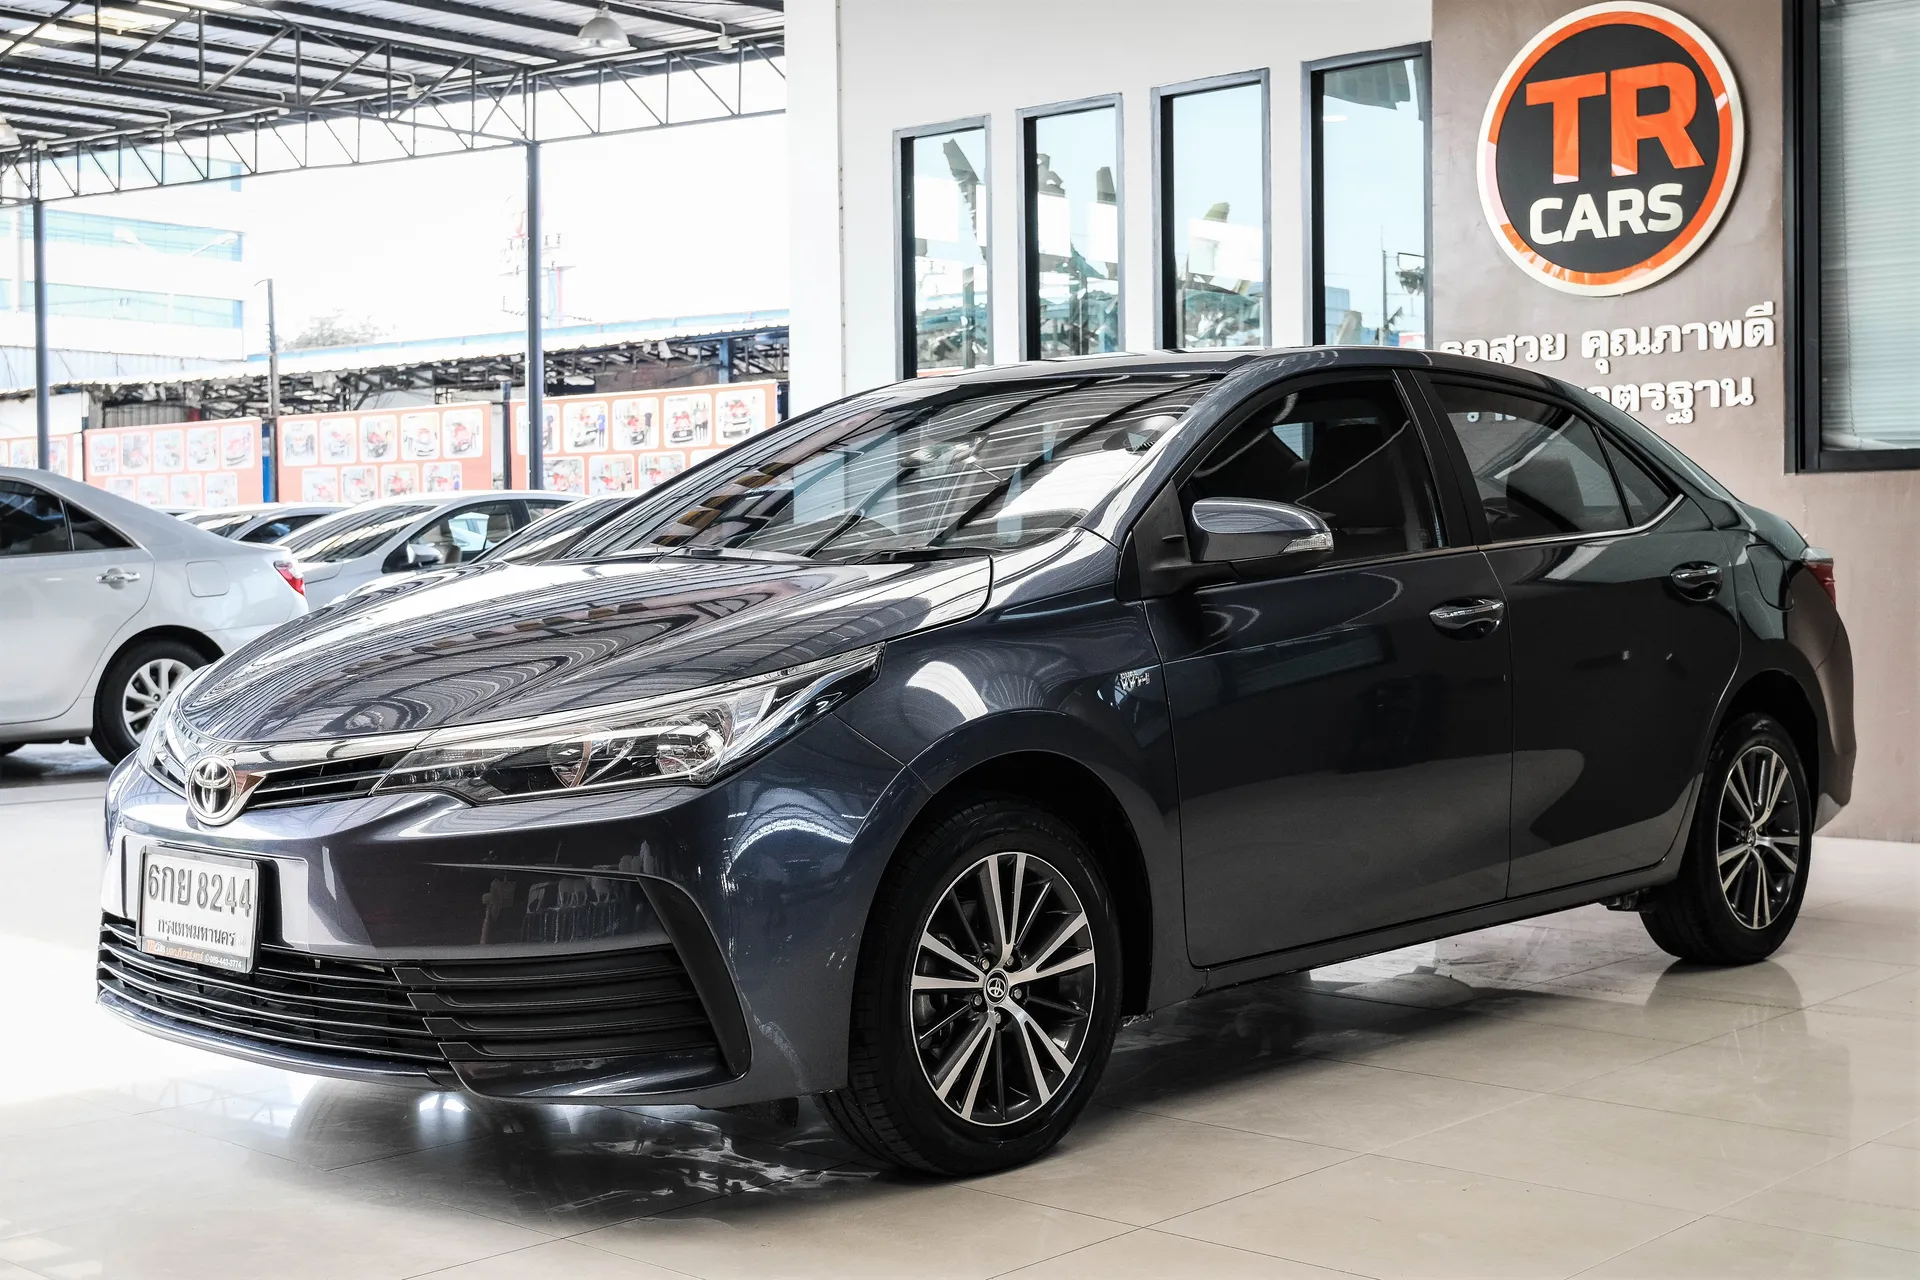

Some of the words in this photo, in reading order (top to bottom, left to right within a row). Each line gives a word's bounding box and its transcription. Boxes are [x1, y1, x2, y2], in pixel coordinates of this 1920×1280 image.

[1526, 62, 1705, 184] TR
[1529, 183, 1684, 245] CARS
[1581, 300, 1776, 375] คุณภาพดี
[1583, 376, 1756, 425] าตรฐาน
[148, 863, 192, 906] 6กย
[196, 872, 252, 918] 8244
[158, 918, 236, 947] กรุงเทพมหานคร
